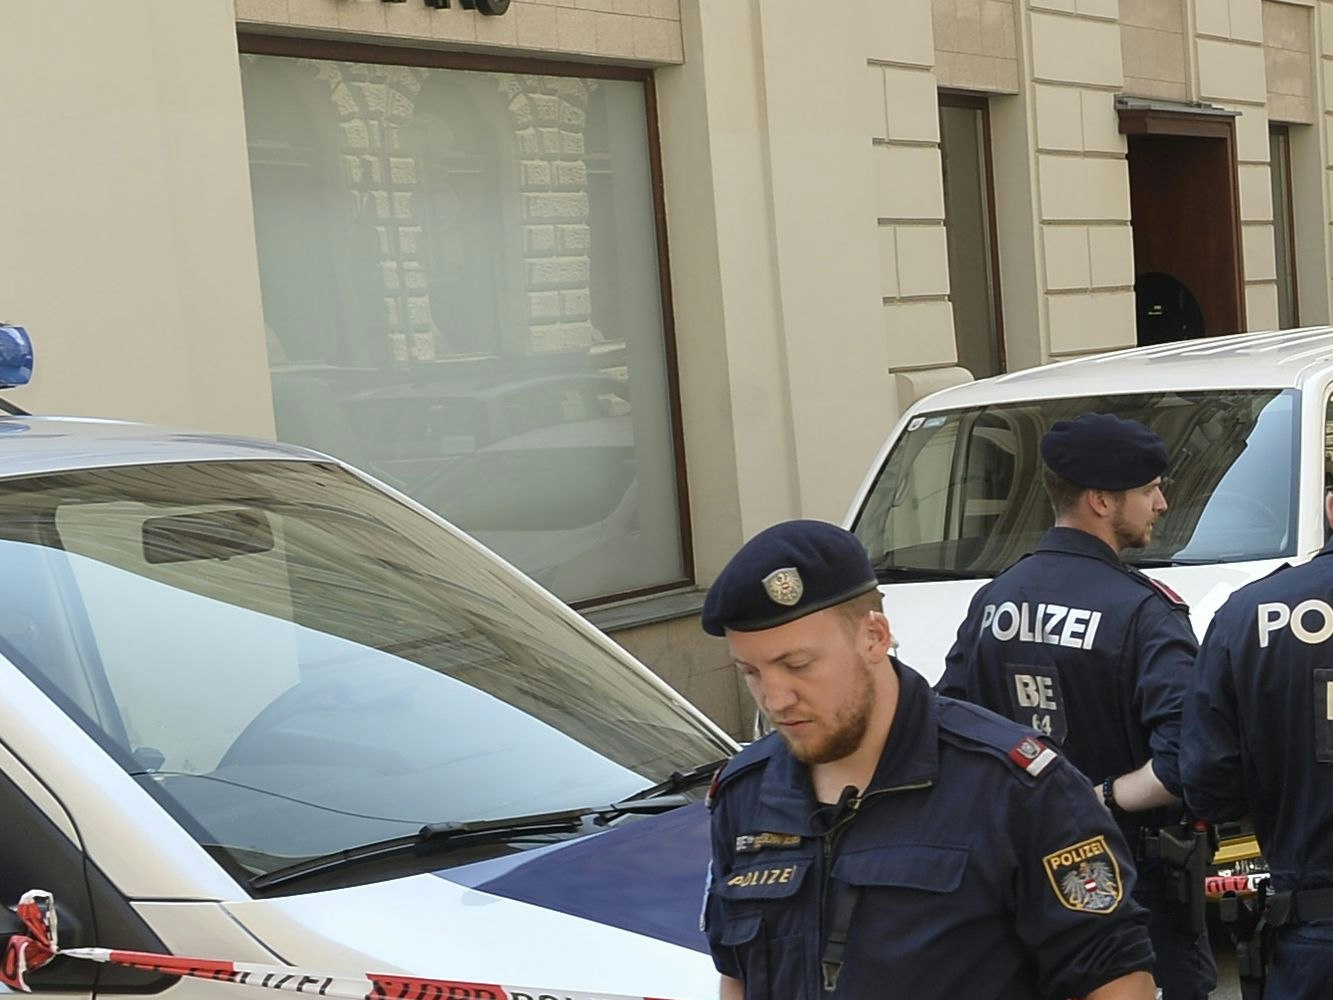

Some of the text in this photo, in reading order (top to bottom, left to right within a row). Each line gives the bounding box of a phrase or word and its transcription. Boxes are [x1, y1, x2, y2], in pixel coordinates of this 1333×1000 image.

[980, 601, 1102, 650] POLIZEI
[1014, 674, 1057, 710] BE
[1032, 713, 1052, 737] 64
[1050, 842, 1105, 870] POLIZEI
